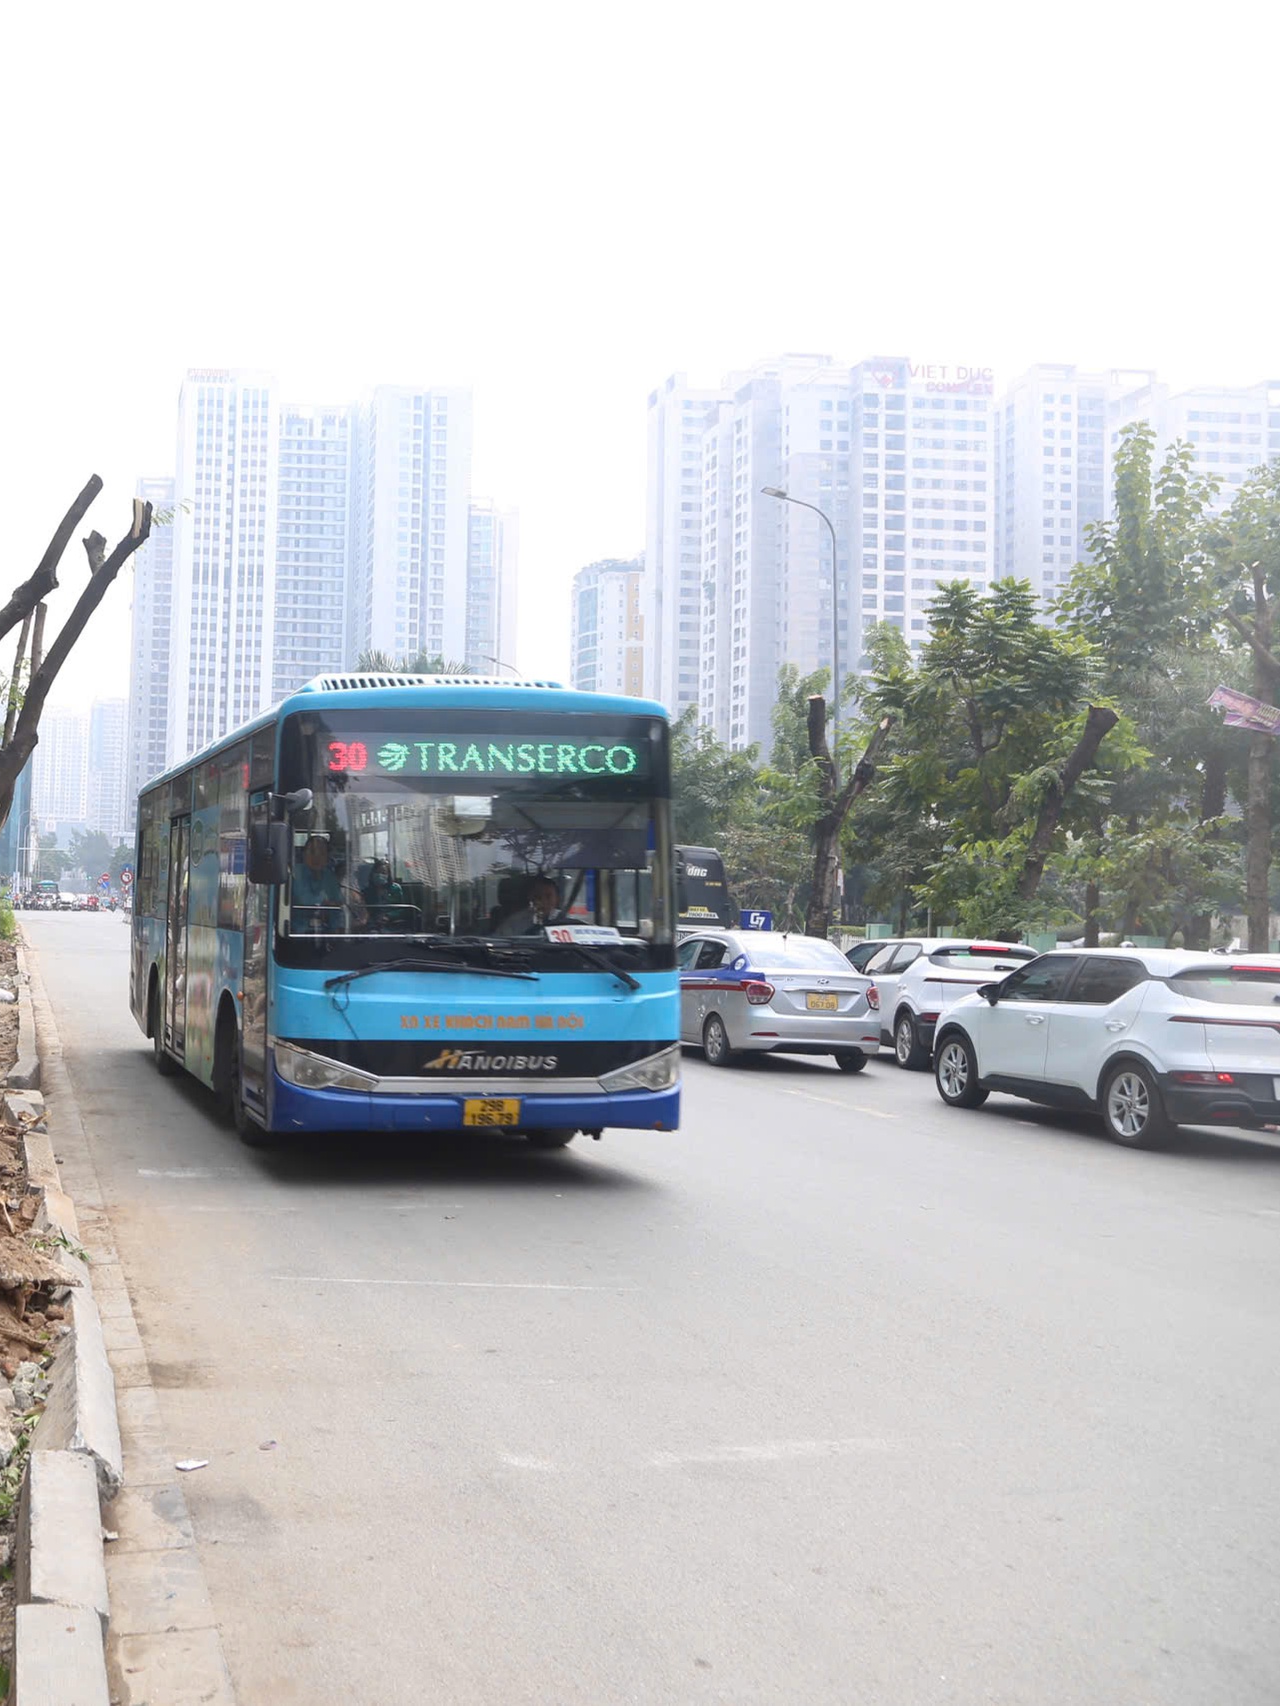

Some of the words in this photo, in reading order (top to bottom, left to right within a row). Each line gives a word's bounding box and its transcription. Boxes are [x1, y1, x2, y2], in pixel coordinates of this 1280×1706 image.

[328, 742, 368, 771] 30
[413, 742, 638, 774] TRANSERCO
[749, 912, 765, 930] G7
[551, 929, 573, 943] 30
[423, 1015, 441, 1029] XE
[496, 1015, 531, 1029] NAM
[423, 1050, 559, 1070] HANOIBUS
[480, 1100, 504, 1112] 29B
